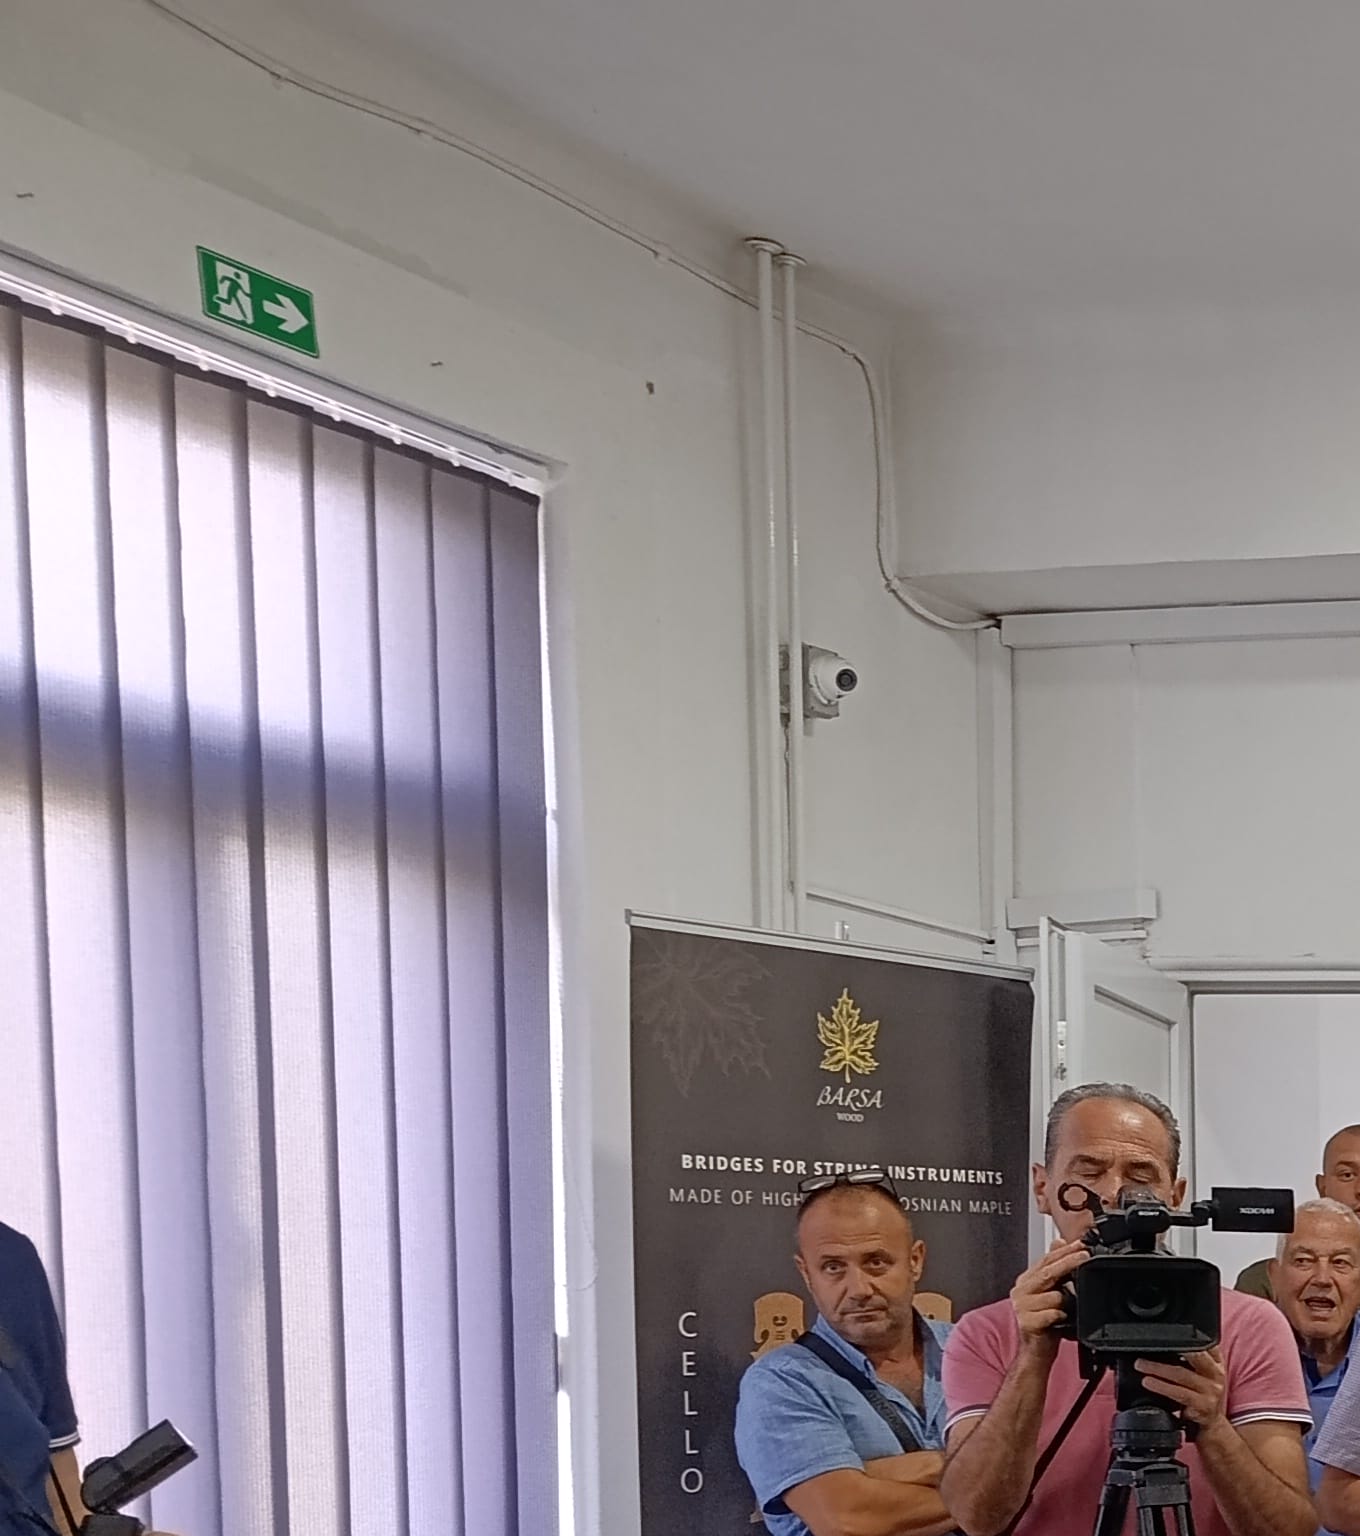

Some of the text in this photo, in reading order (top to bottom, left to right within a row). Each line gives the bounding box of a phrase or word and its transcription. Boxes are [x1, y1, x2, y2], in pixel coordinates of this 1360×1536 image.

[816, 1085, 883, 1111] BARSA
[836, 1112, 865, 1122] WOOD
[681, 1153, 764, 1173] BRIDGES
[772, 1159, 807, 1175] FOR
[887, 1165, 1003, 1185] INSTRUMENTS
[669, 1187, 723, 1204] MADE
[731, 1189, 754, 1205] OF
[899, 1196, 962, 1212] OSNIAN
[969, 1200, 1012, 1215] MAPLE
[678, 1311, 703, 1494] CELLO
